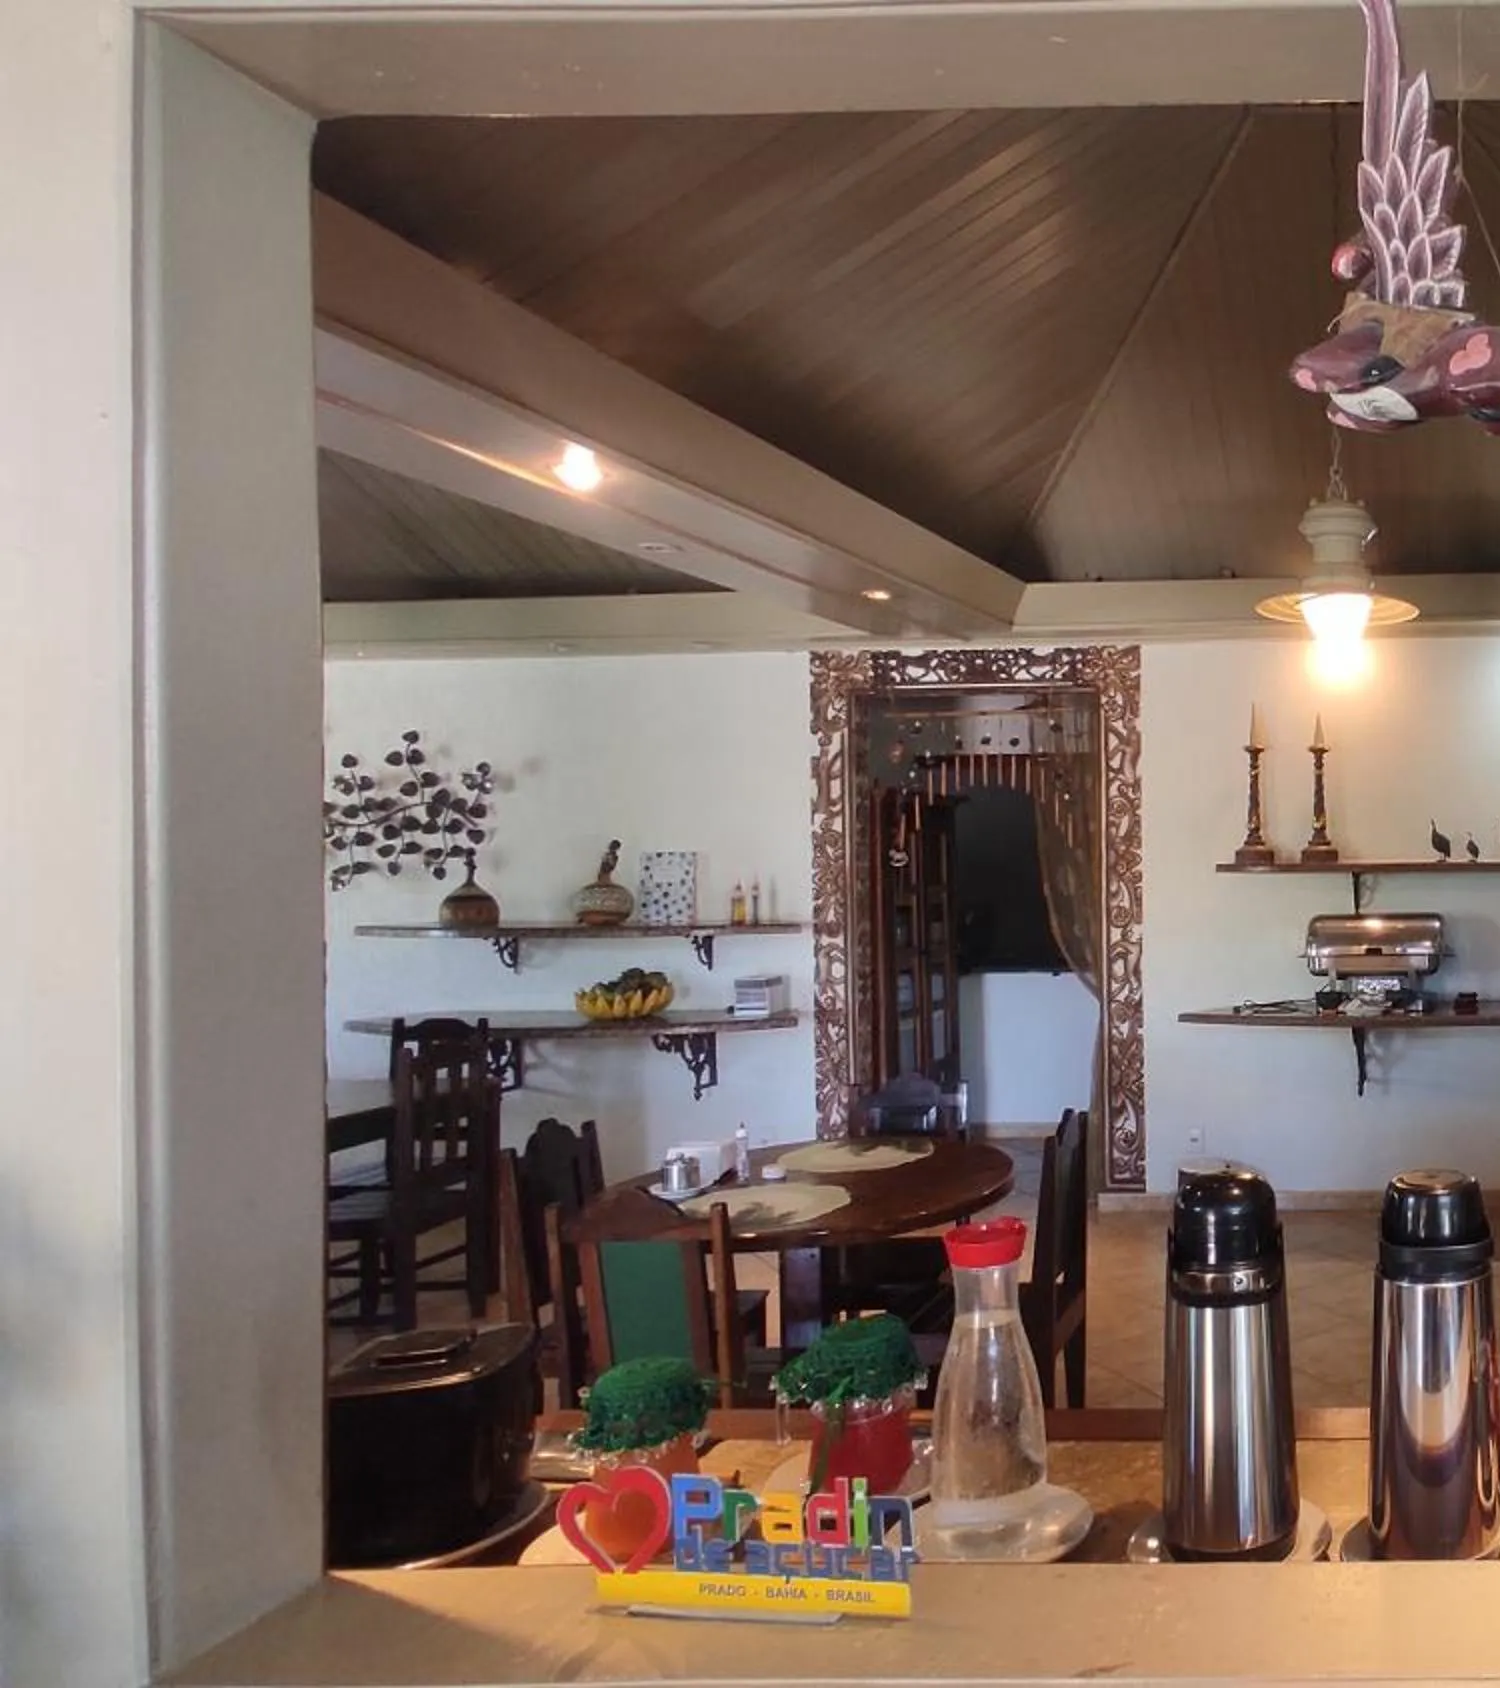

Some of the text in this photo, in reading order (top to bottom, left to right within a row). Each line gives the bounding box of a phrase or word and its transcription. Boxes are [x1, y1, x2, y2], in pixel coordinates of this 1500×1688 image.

[672, 1473, 914, 1552] Pradin
[699, 1583, 876, 1603] PRADO BAHIA BRASIL
